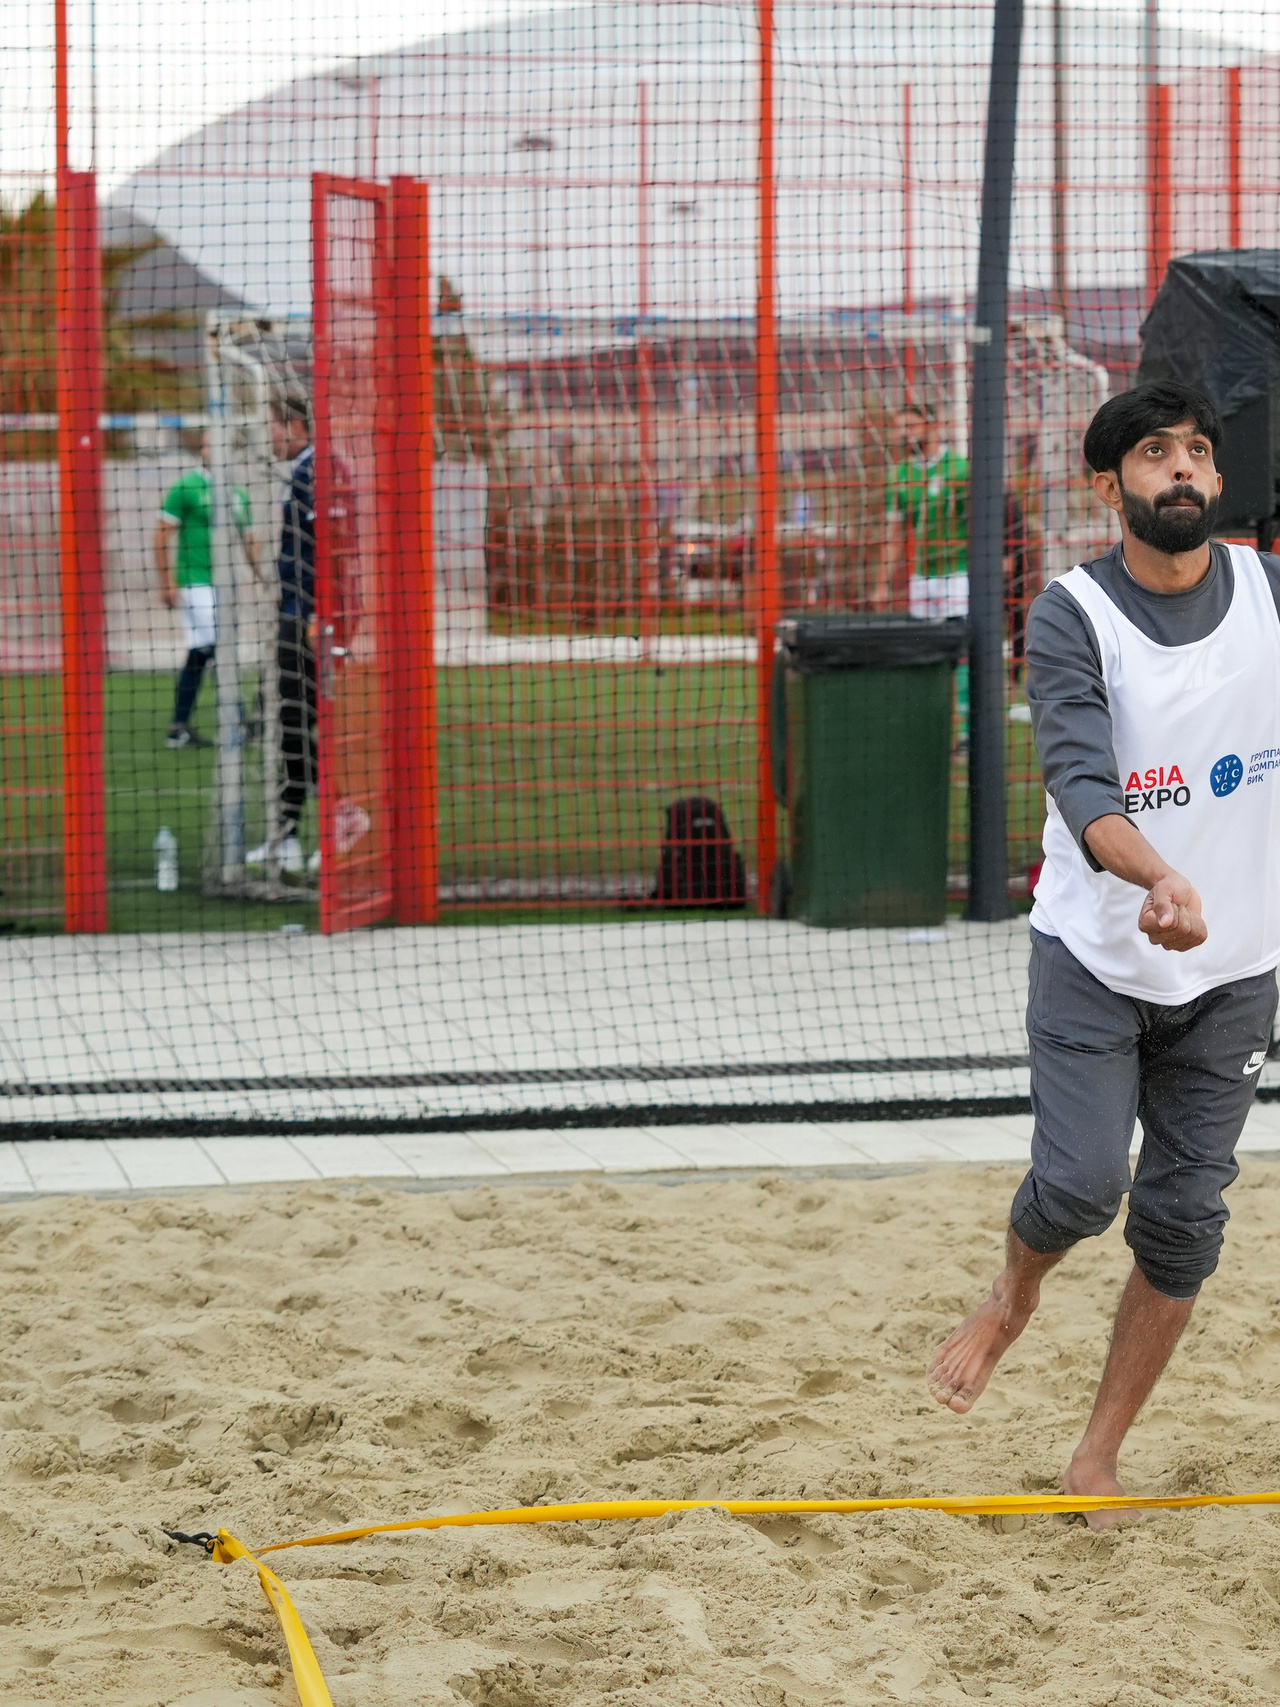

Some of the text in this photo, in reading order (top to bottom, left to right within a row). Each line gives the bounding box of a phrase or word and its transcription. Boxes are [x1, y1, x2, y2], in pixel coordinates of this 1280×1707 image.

[1250, 748, 1280, 763] ГРУППА
[1125, 765, 1184, 792] ASIA
[1246, 773, 1264, 786] ВИК
[1125, 786, 1191, 814] EXPO
